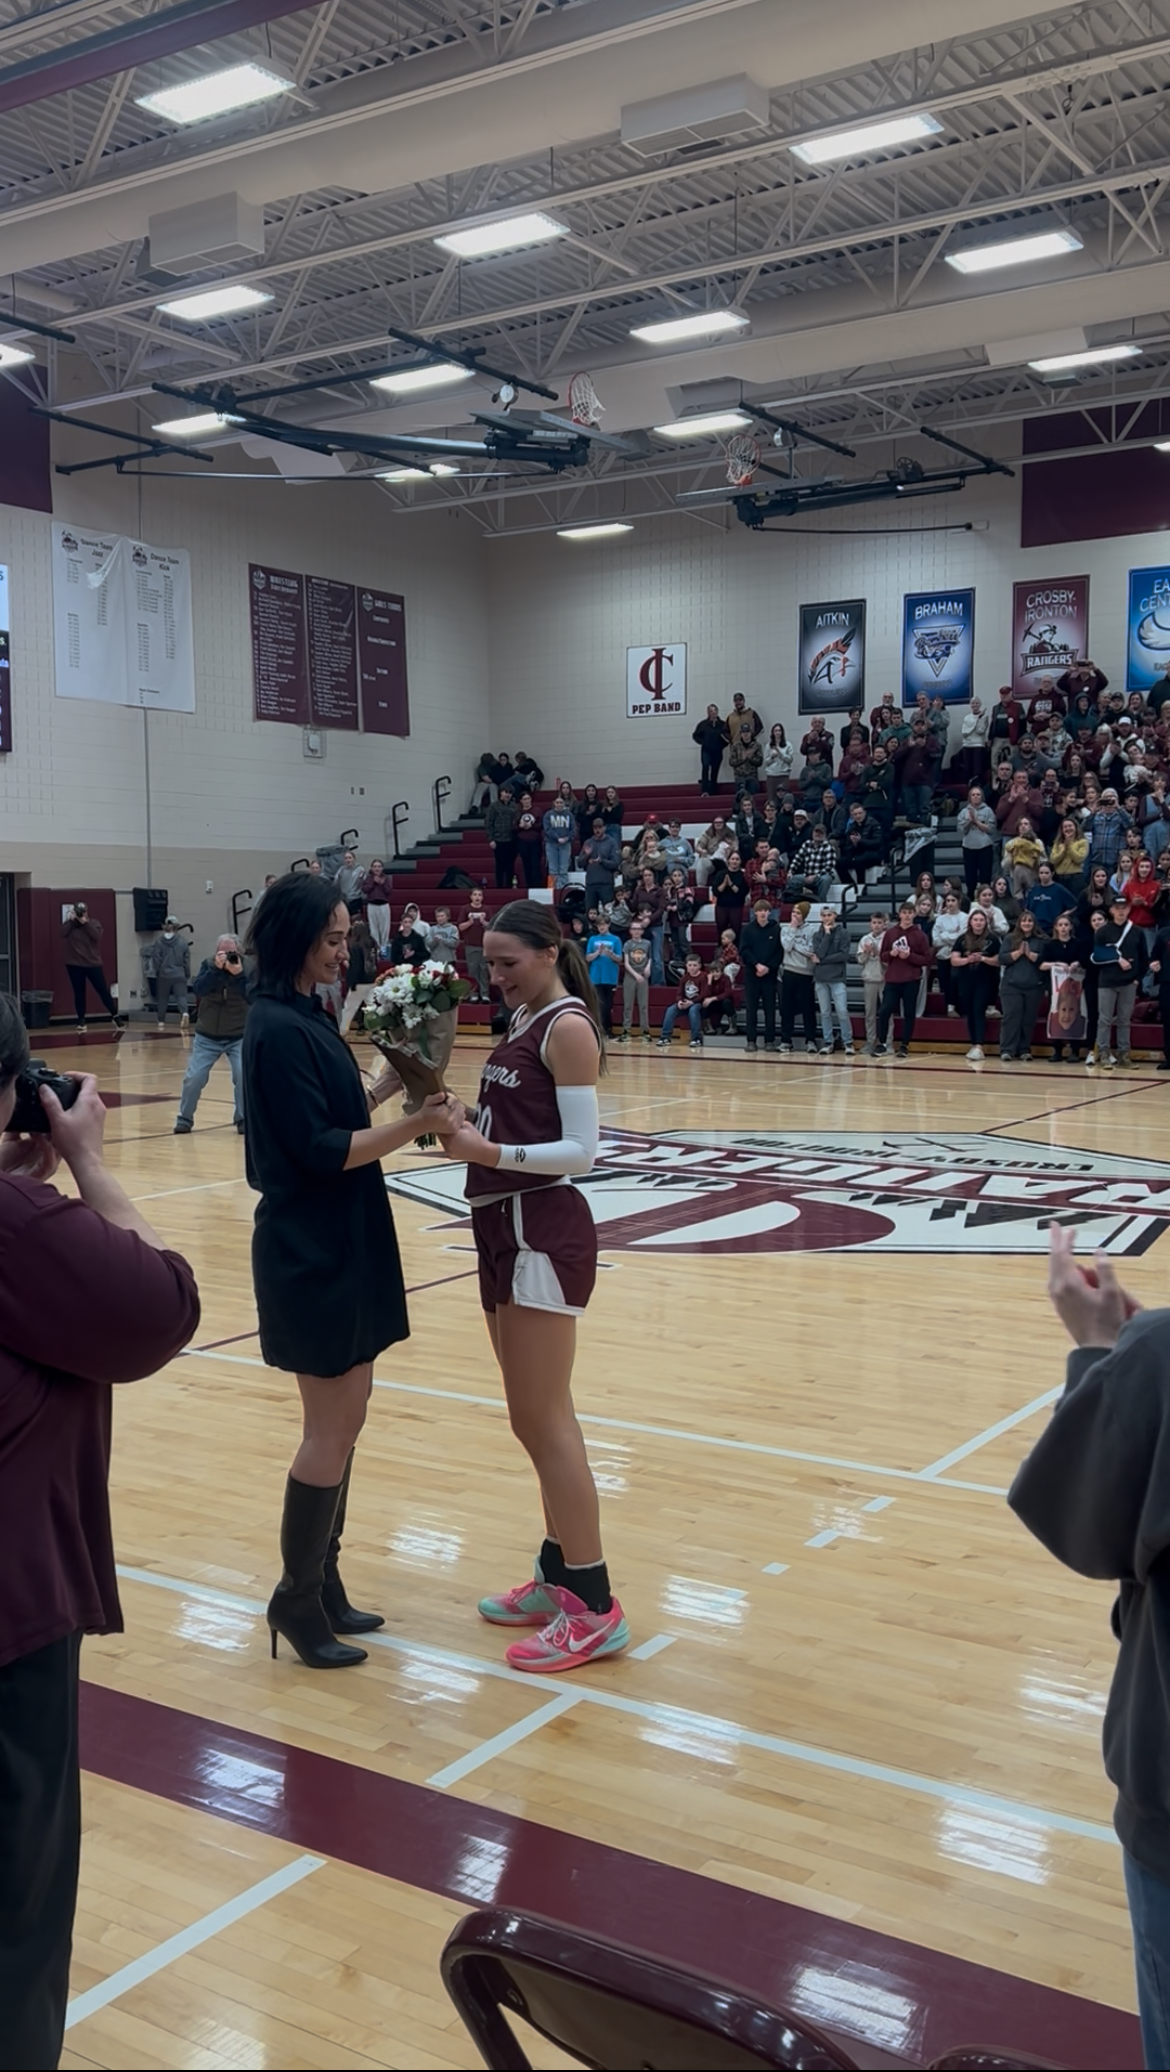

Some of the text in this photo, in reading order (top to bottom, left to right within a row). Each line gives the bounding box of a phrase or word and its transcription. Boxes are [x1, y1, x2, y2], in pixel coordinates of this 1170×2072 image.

[150, 552, 167, 563] Dance
[167, 556, 180, 565] Team
[159, 563, 170, 572] Kick
[914, 601, 964, 621] BRAHAM
[1024, 604, 1078, 624] IRONTON
[815, 611, 850, 630] AITKIN
[1027, 653, 1073, 669] RANGERS
[632, 702, 681, 715] PEP BAND
[550, 814, 570, 828] MN
